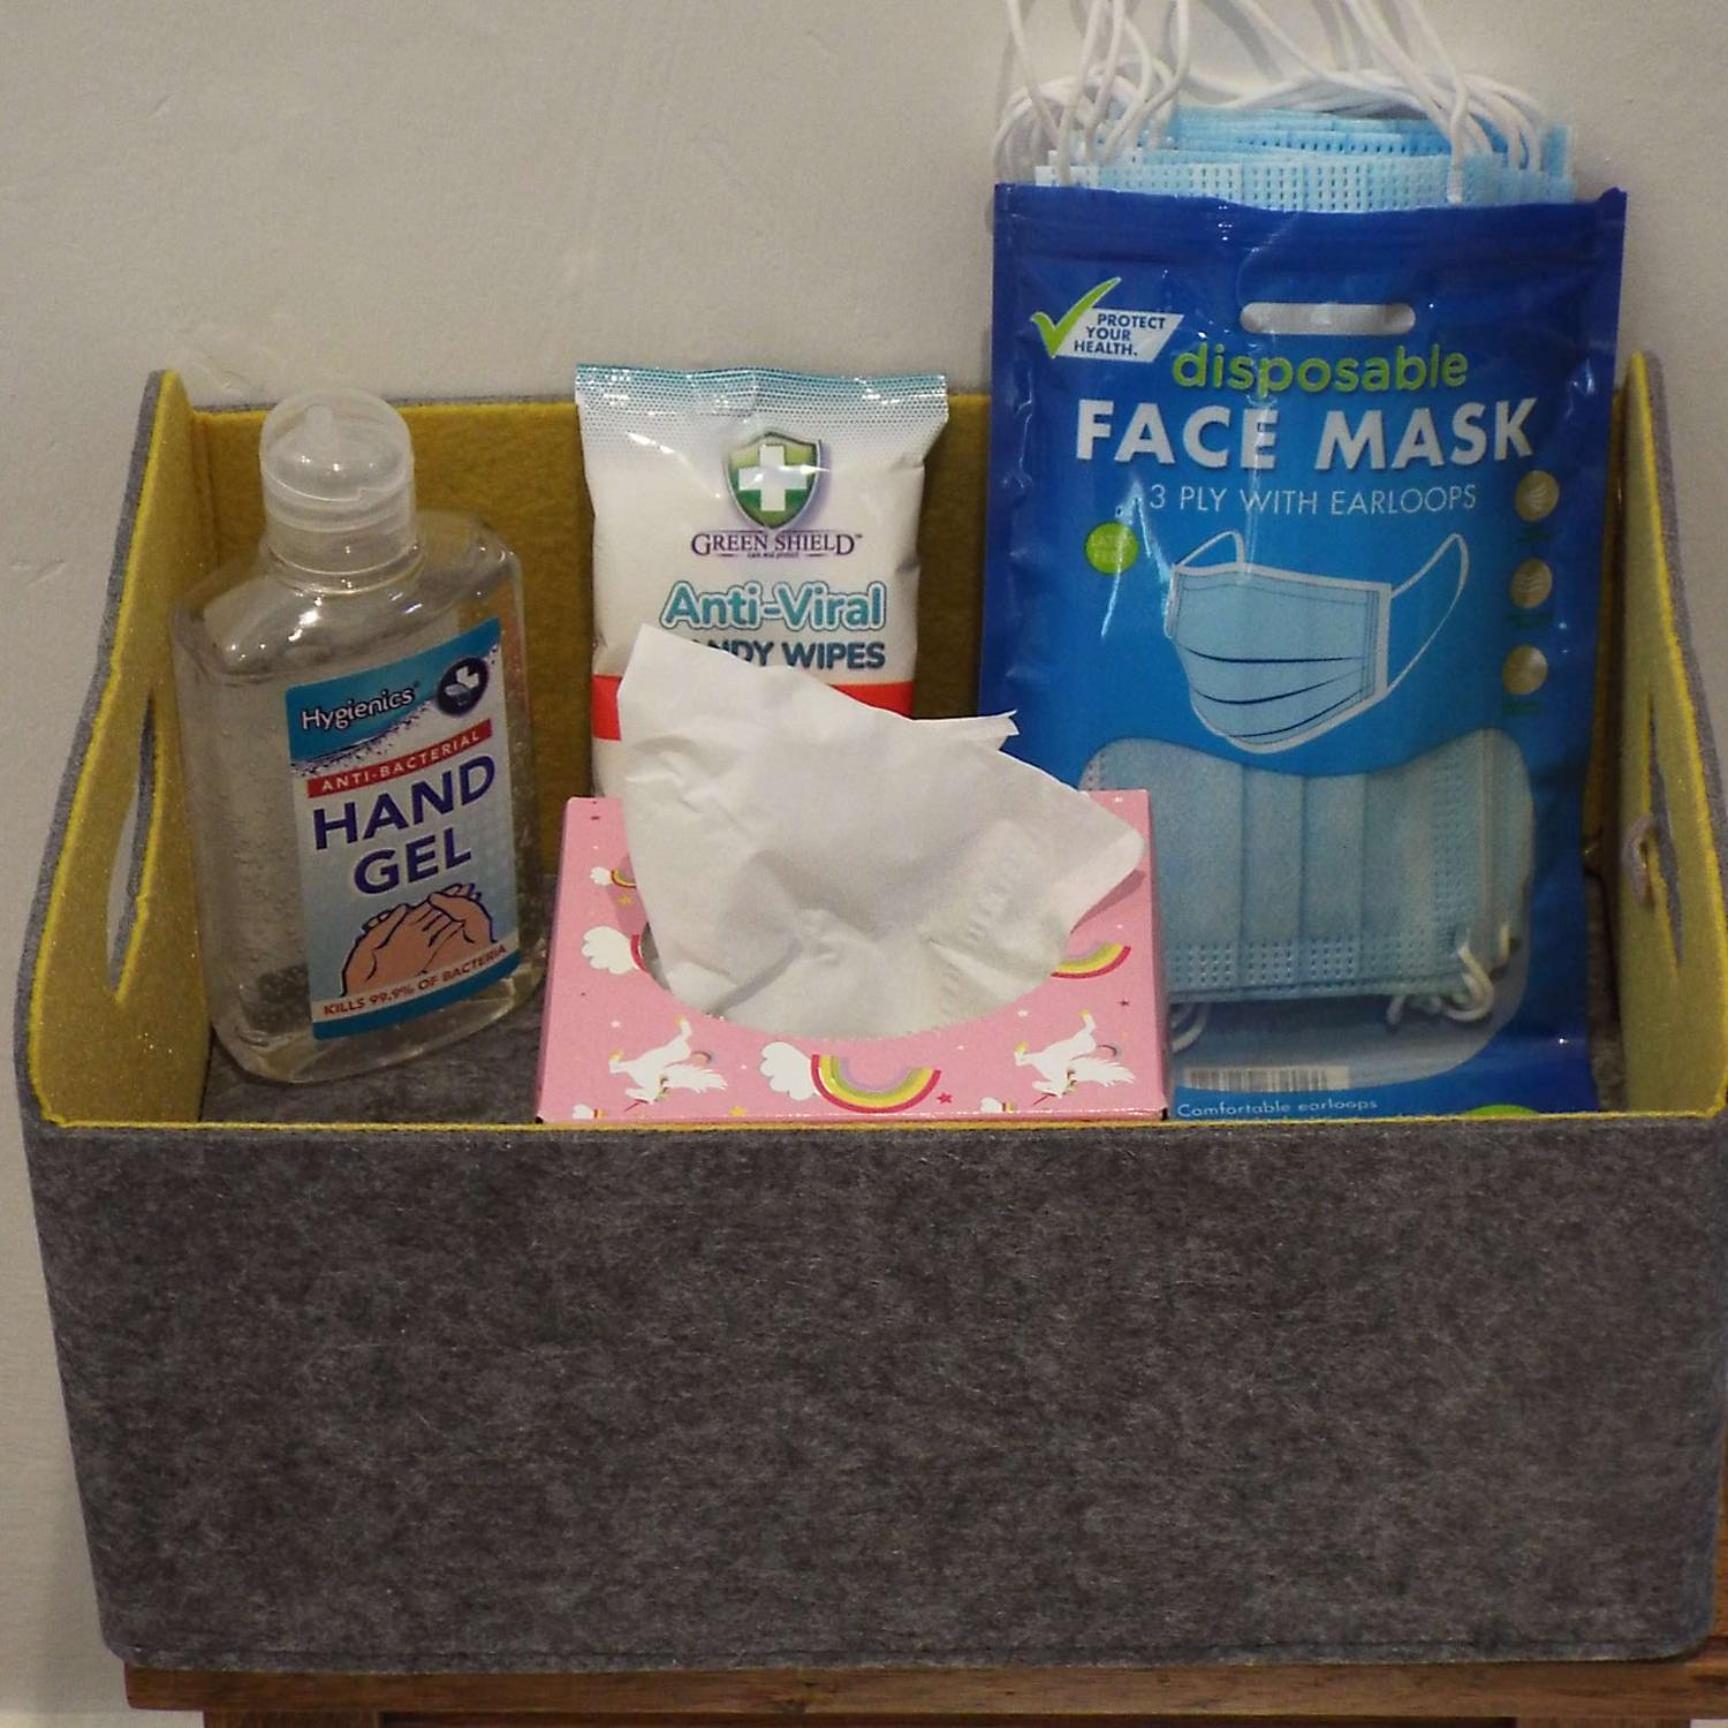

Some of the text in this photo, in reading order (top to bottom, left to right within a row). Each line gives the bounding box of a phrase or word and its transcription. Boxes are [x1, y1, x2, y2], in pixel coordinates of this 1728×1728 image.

[1086, 326, 1131, 341] YOUR
[1097, 314, 1166, 329] PROTECT
[1074, 340, 1138, 356] HEALTH.
[1172, 344, 1468, 401] disposable
[1075, 398, 1537, 470] FACE MASK
[1149, 484, 1477, 515] 3 PLY WITH EARLOOPS
[691, 532, 768, 556] GREEN
[660, 580, 886, 630] Anti-Viral
[781, 641, 886, 670] WIPES
[301, 687, 415, 731] Hygienics
[321, 732, 481, 792] ANTI-BACTERIAL
[313, 755, 496, 849] HAND
[354, 827, 472, 895] GEL
[324, 945, 507, 1015] KILLS 99.9% OF BACTERIA
[1177, 1099, 1378, 1118] Comfortable earloops
